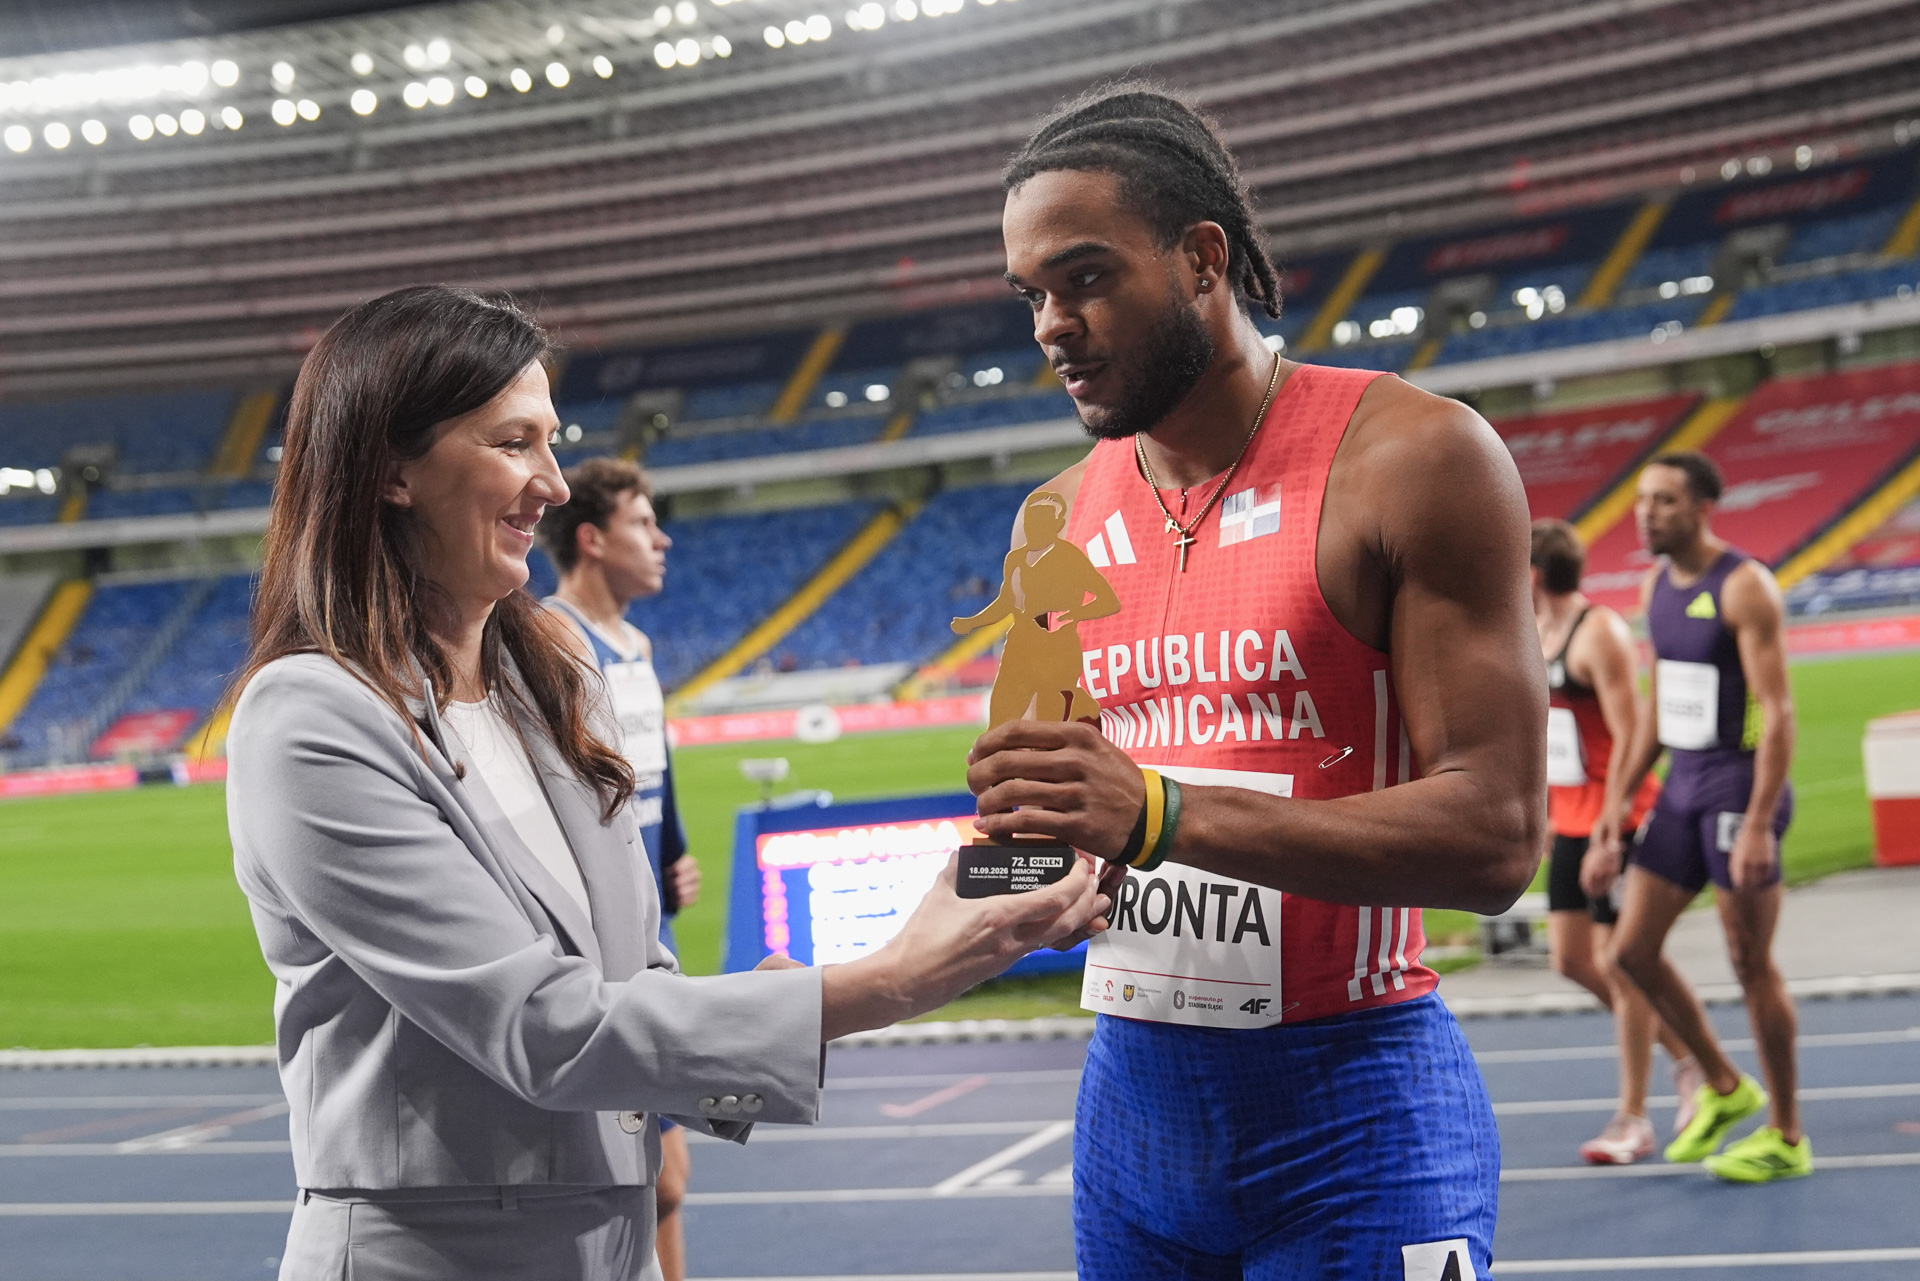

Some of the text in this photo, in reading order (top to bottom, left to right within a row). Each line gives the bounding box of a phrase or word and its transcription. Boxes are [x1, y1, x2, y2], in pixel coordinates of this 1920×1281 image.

[1077, 629, 1307, 699] EPUBLICA
[1100, 690, 1325, 749] OMINICANA
[1011, 857, 1061, 867] 72. ORLEN
[1188, 1001, 1207, 1009] STADION
[1239, 998, 1271, 1014] 4F
